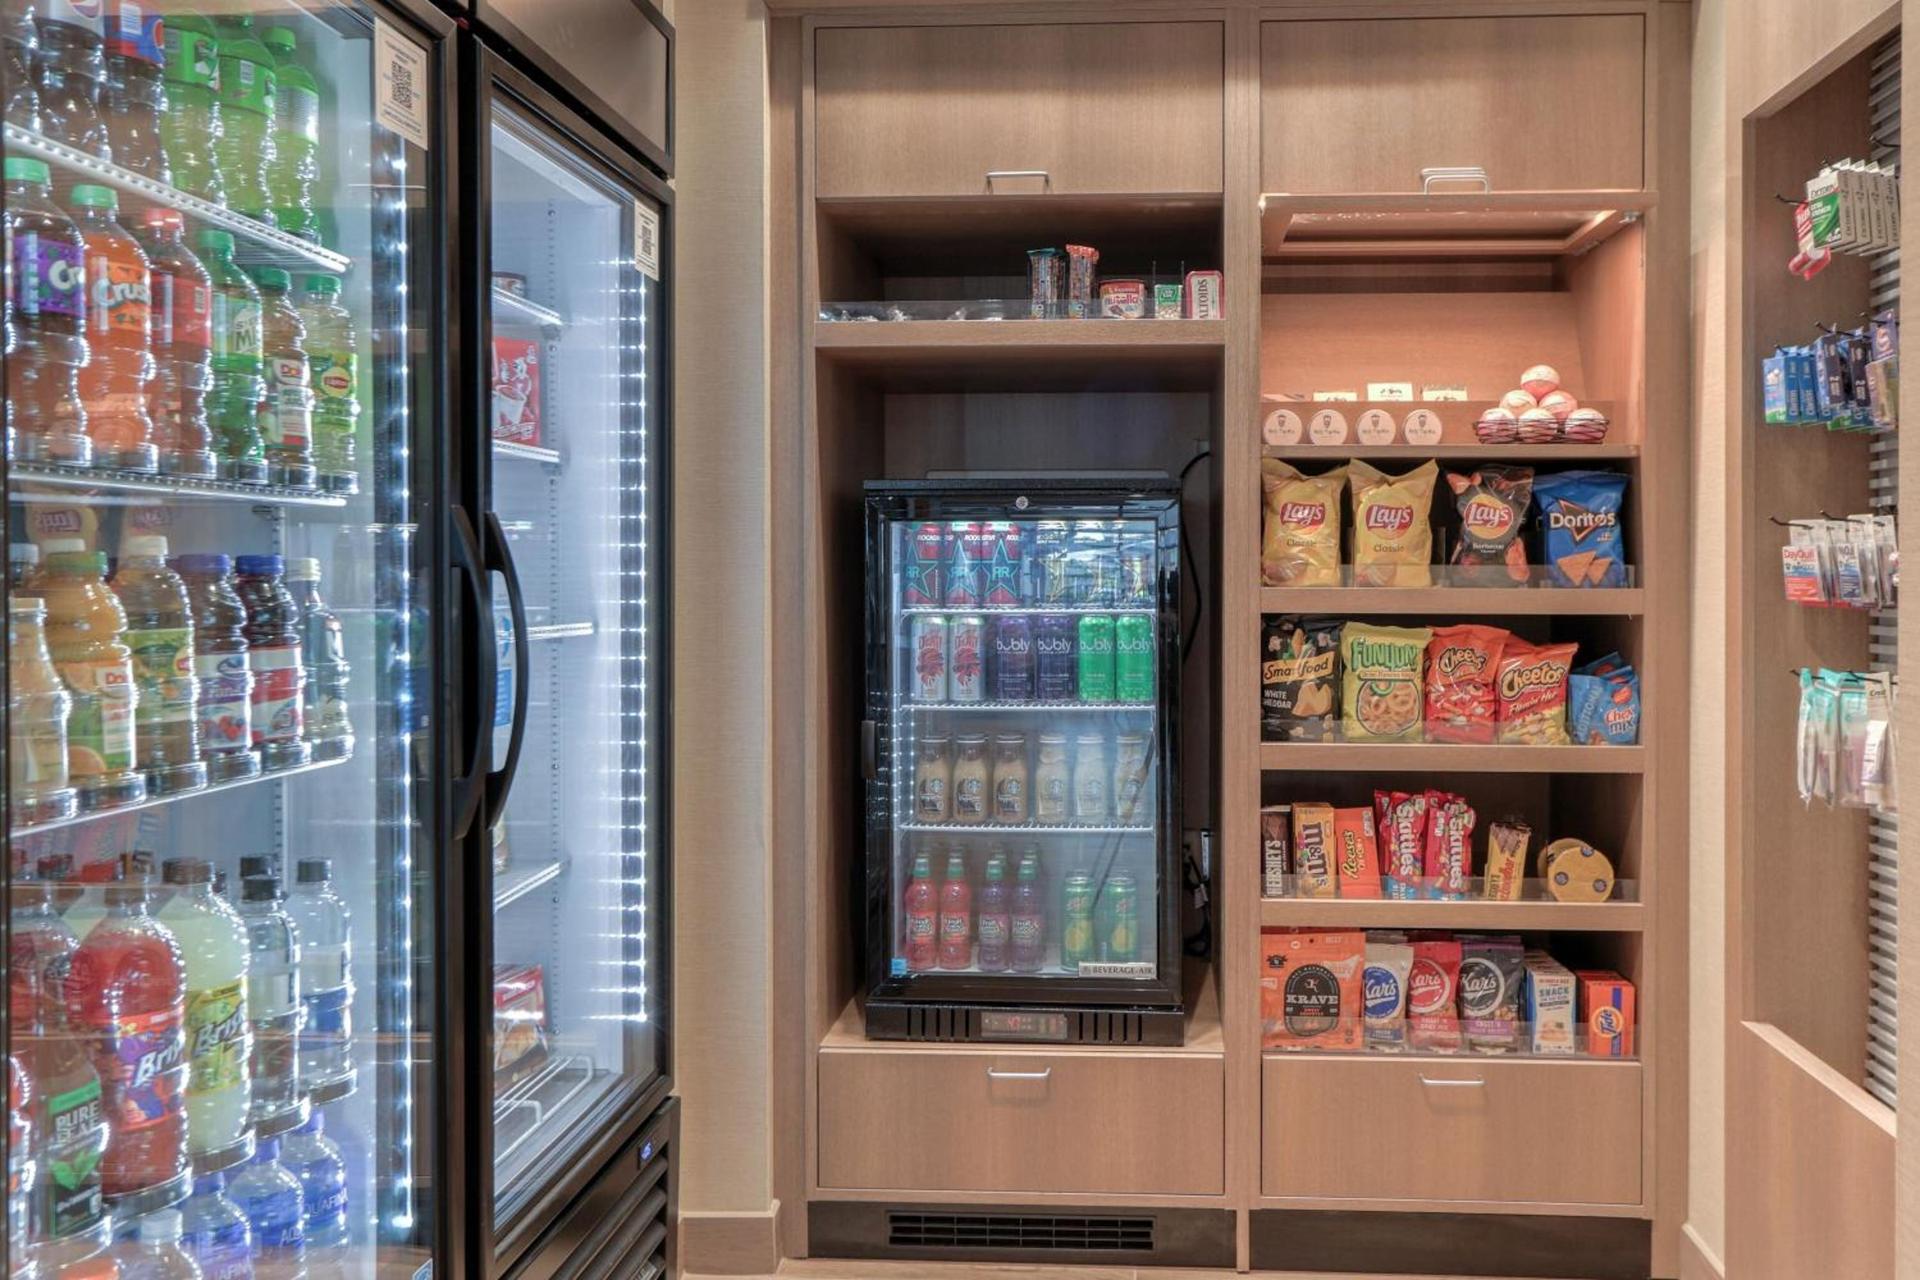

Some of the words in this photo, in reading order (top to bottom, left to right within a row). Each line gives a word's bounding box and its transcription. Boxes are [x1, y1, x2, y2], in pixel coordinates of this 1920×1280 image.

[1197, 278, 1210, 319] ALTOIDS
[1550, 510, 1616, 529] Doritos
[1263, 658, 1329, 681] Smafood
[1500, 662, 1567, 699] Cheetos
[1264, 689, 1288, 700] WHITE
[1396, 801, 1417, 876] Skittles
[1265, 840, 1283, 896] HERSHEY'S
[1286, 994, 1339, 1005] KRAVE
[55, 1100, 99, 1129] PURE
